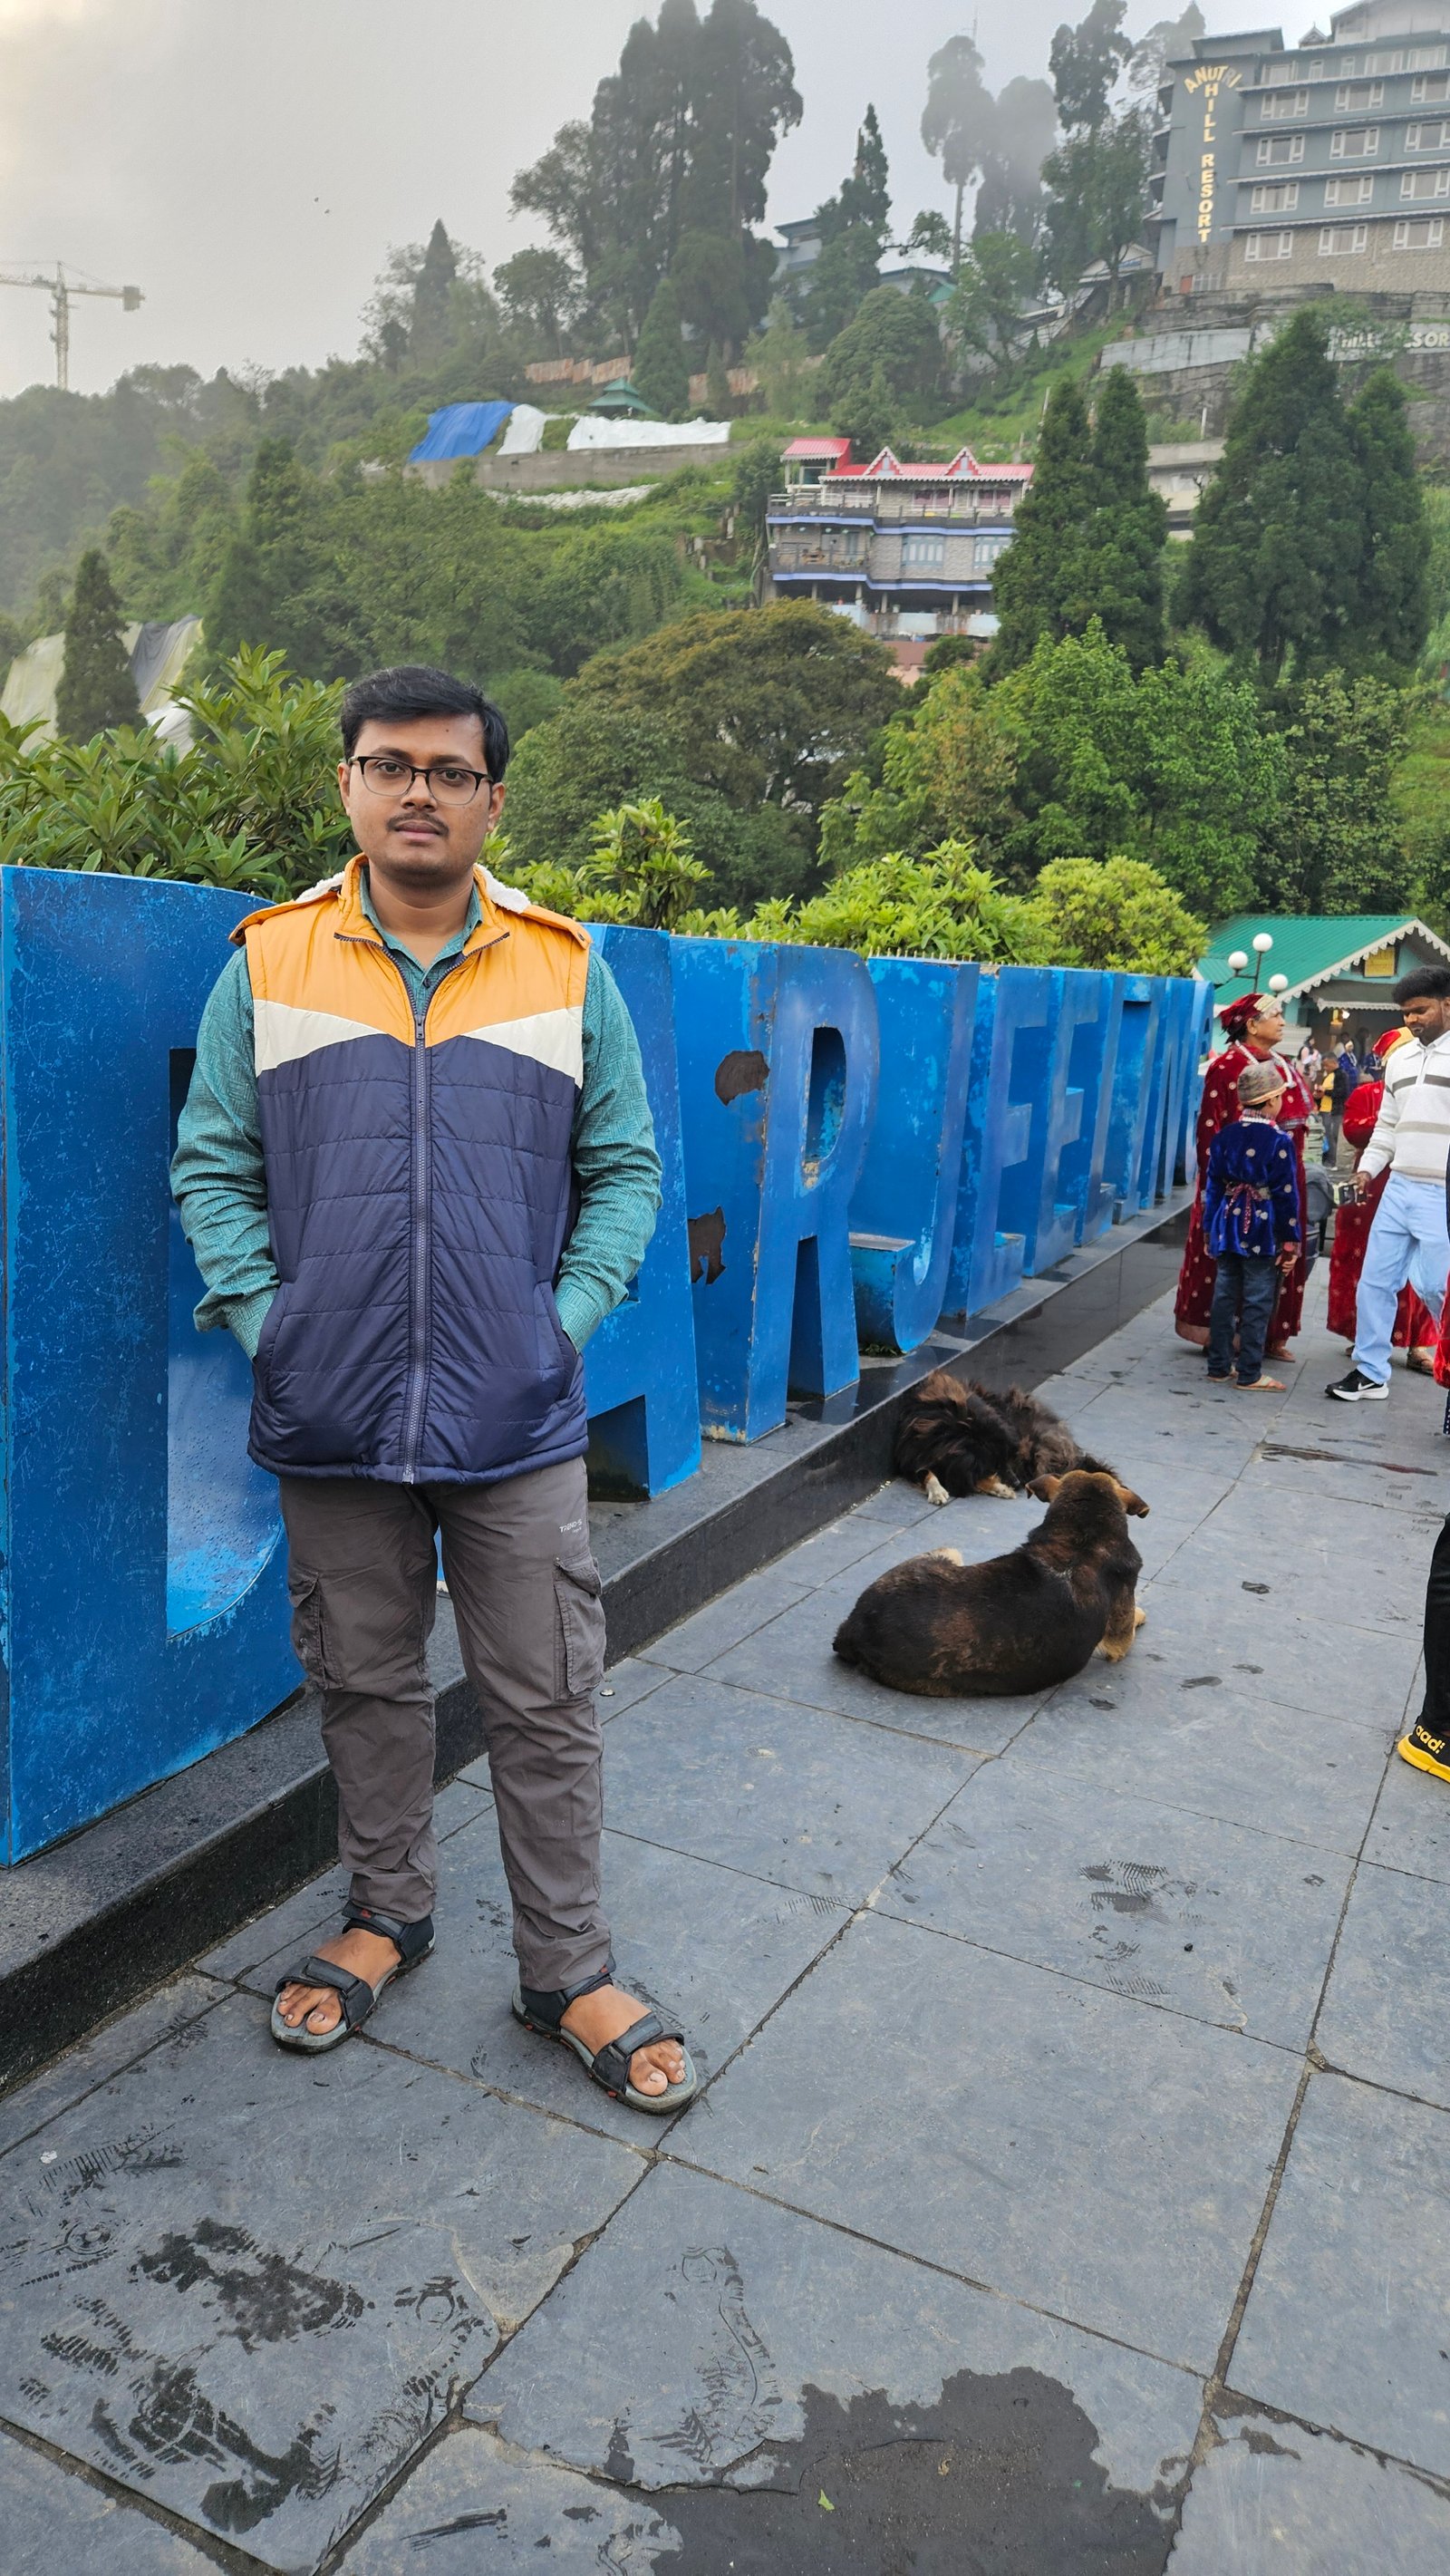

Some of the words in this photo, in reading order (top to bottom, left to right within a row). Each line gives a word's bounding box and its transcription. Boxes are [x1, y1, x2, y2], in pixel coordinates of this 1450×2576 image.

[1184, 65, 1242, 94] ANUTRI
[1204, 82, 1219, 142] HILL
[1197, 153, 1215, 243] RESORT
